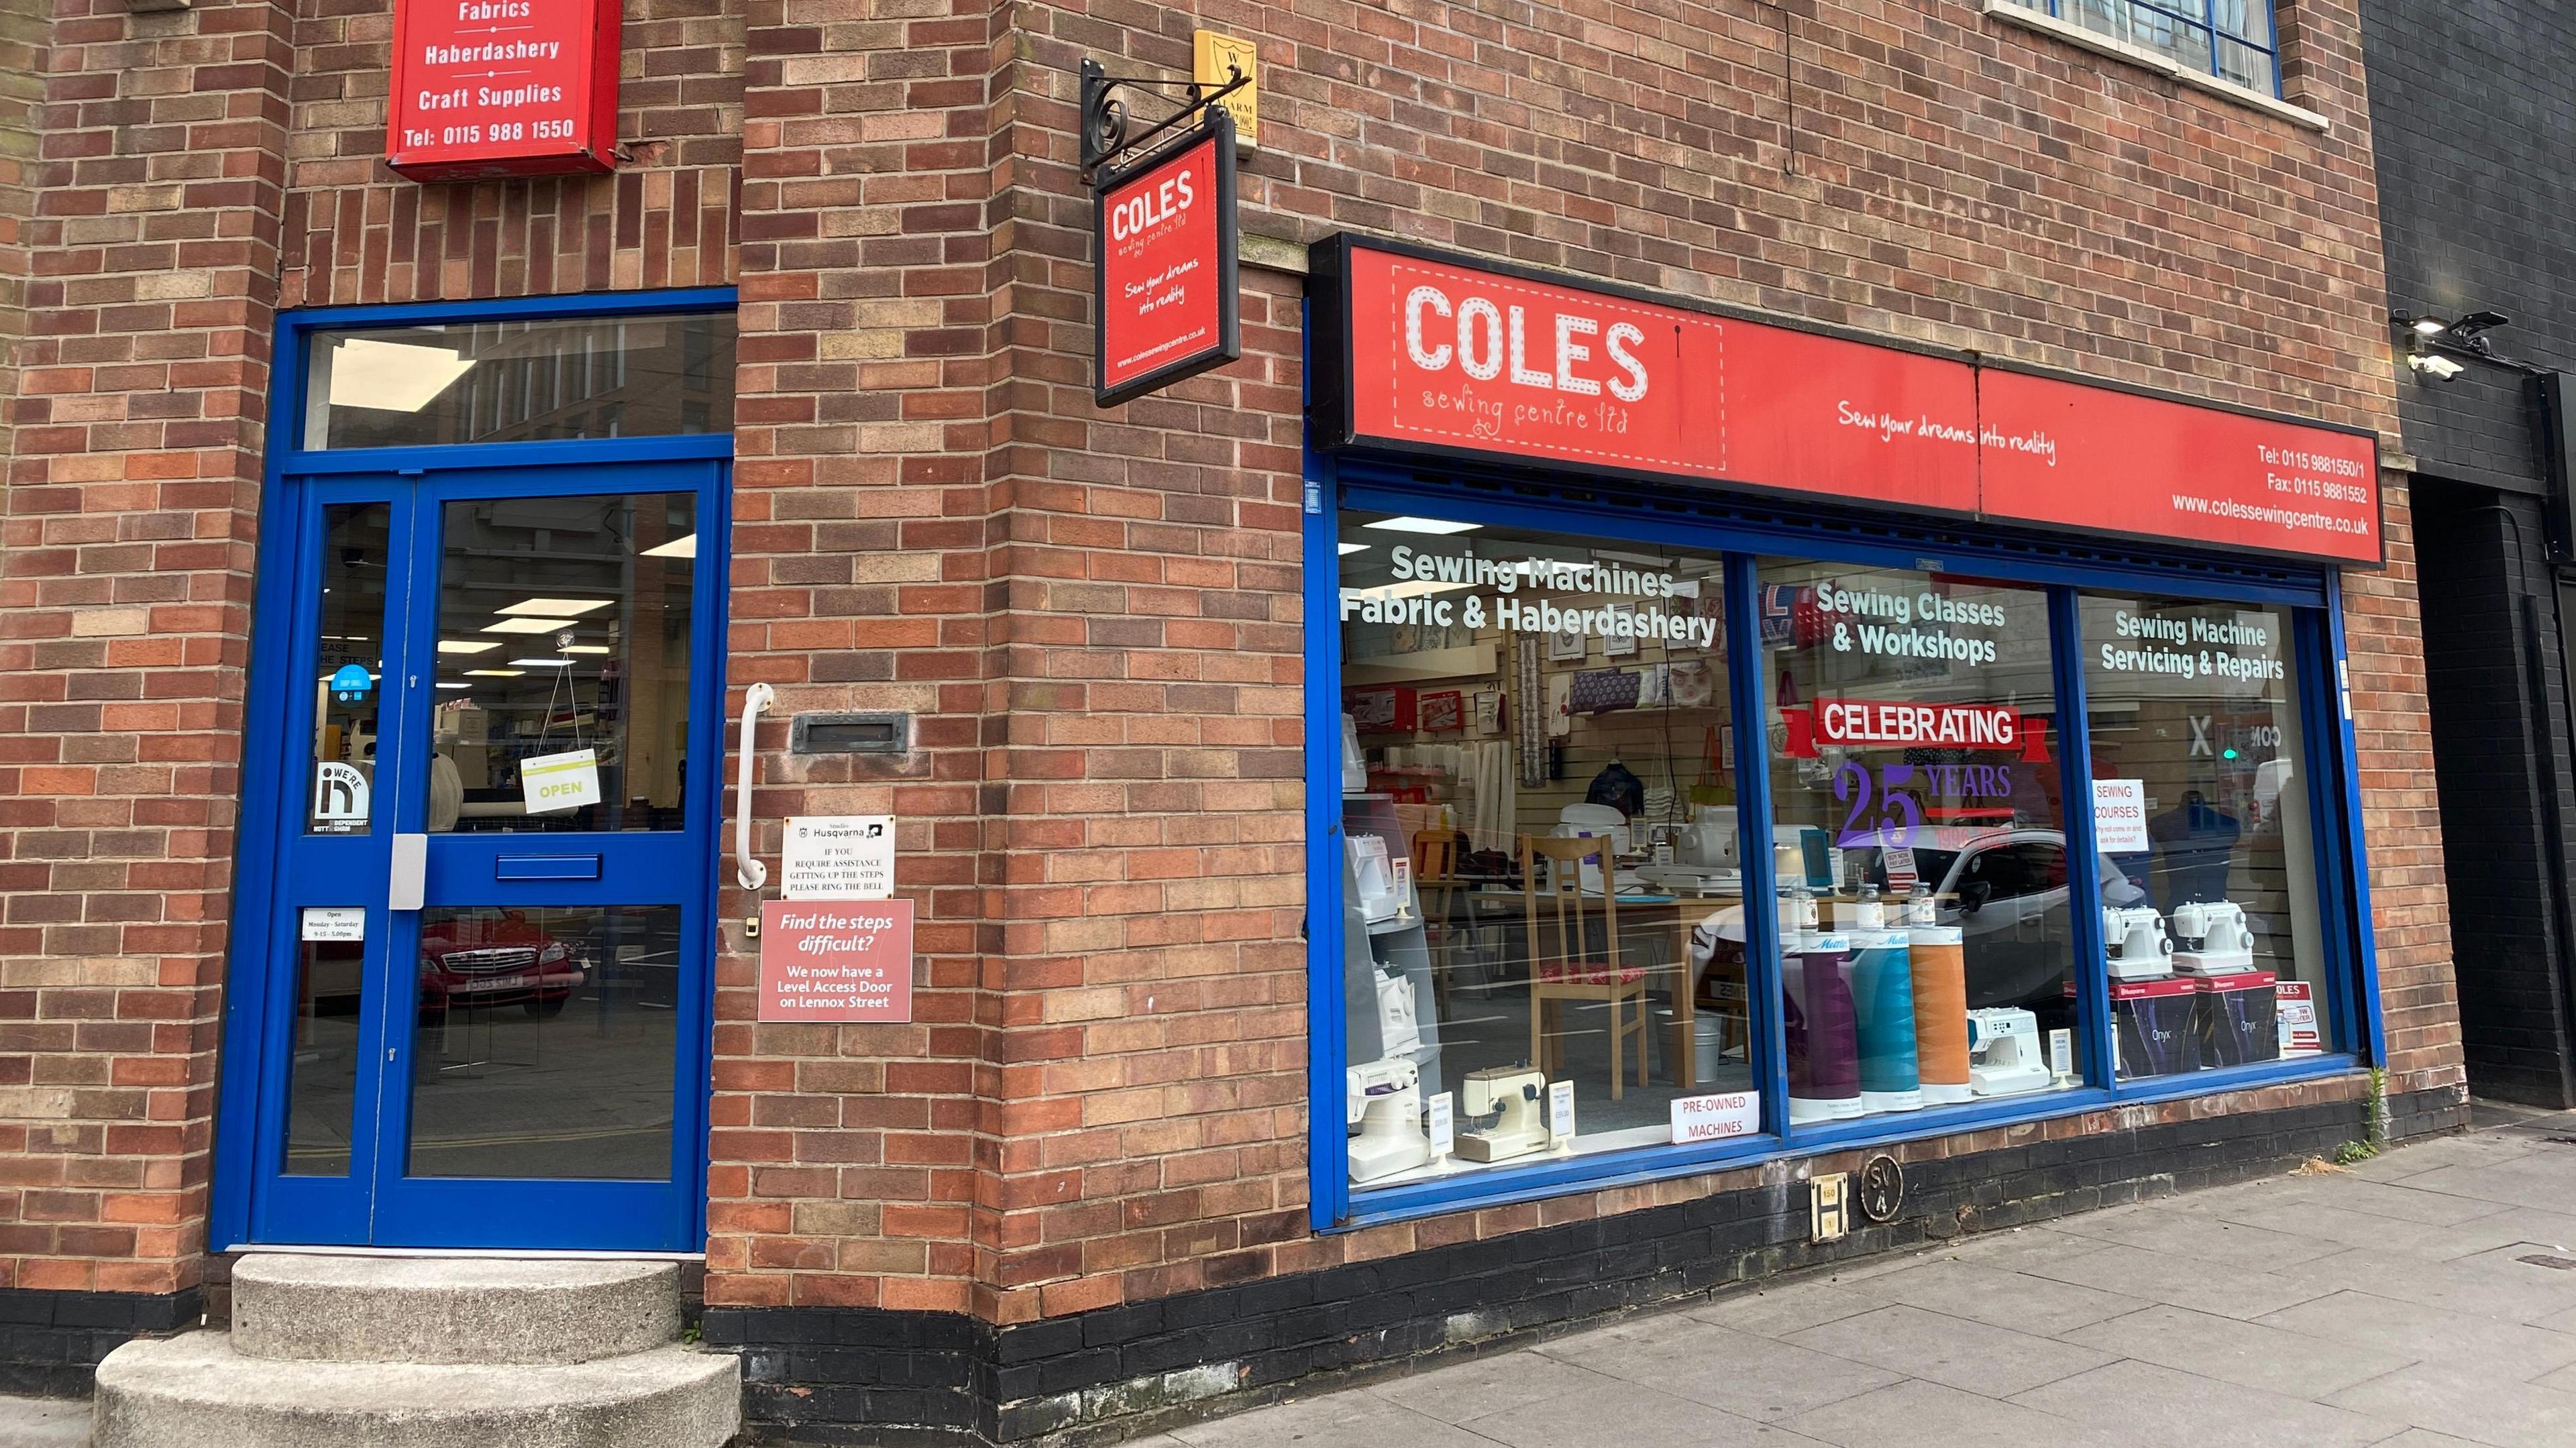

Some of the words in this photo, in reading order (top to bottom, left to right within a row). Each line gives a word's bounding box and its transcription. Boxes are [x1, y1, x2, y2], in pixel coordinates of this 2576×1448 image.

[459, 0, 530, 21] Fabrics
[425, 40, 560, 64] Haberdashery
[419, 89, 468, 110] Craft
[478, 85, 561, 108] Supplies
[405, 129, 435, 147] Tel:
[443, 125, 480, 146] 0115
[489, 123, 523, 142] 988
[532, 119, 574, 139] 1550
[1112, 170, 1194, 241] COLES
[1118, 237, 1145, 258] sewing
[1146, 223, 1173, 246] centre
[1174, 213, 1187, 229] ltd
[1125, 282, 1145, 298] Sew
[1146, 273, 1164, 295] your
[1166, 258, 1199, 280] dreams
[1139, 296, 1155, 316] into
[1156, 284, 1185, 308] reality
[1117, 326, 1206, 368] www.colessewingcentre.co.uk
[1405, 285, 1649, 402] COLES
[1422, 384, 1505, 437] sewing
[1514, 398, 1589, 430] centre
[1595, 402, 1629, 435] ltd
[1837, 400, 1876, 429] Sew
[1880, 412, 1914, 443] your
[1918, 414, 1976, 444] dreams
[1979, 424, 2006, 449] into
[2009, 430, 2057, 467] reality
[2257, 444, 2279, 463] Tel:
[2282, 449, 2308, 469] 0115
[2310, 455, 2365, 480] 9881550/1
[2267, 472, 2292, 492] Fax:
[2294, 477, 2321, 497] 0115
[2322, 481, 2367, 504] 9881552
[2172, 493, 2369, 536] www.colessewingcentre.co.uk
[1391, 545, 1518, 593] Sewing
[1528, 556, 1674, 598] Machines
[1817, 581, 1911, 624] Sewing
[1917, 592, 2006, 627] Classes
[1339, 587, 1453, 628] Fabric
[1462, 595, 1487, 629] &
[1497, 596, 1717, 648] Haberdashery
[2115, 610, 2186, 646] Sewing
[2192, 616, 2267, 647] Machine
[321, 644, 350, 653] EASE
[1833, 622, 1851, 652] &
[1857, 624, 1996, 667] Workshops
[320, 655, 334, 664] HE
[339, 656, 374, 665] STEPS
[2102, 643, 2194, 679] Servicing
[2199, 653, 2212, 675] &
[2216, 652, 2284, 682] Repairs
[1823, 703, 2013, 745] CELEBRATING
[320, 768, 354, 814] in
[334, 768, 362, 790] WE'RE
[539, 781, 582, 798] OPEN
[2096, 785, 2133, 797] SEWING
[1833, 761, 1920, 850] 25
[1925, 764, 2012, 797] YEARS
[2094, 806, 2139, 819] COURSES
[814, 828, 864, 838] Husqvarna
[796, 860, 831, 869] REQUIRE
[833, 859, 881, 867] ASSISTANCE
[335, 921, 359, 929] Saturday
[780, 913, 818, 930] Find
[819, 913, 847, 930] the
[849, 915, 894, 934] steps
[798, 935, 874, 956] difficult?
[786, 965, 808, 978] We
[811, 968, 839, 978] now
[841, 965, 872, 978] have
[875, 968, 883, 978] a
[777, 981, 810, 993] Level
[813, 981, 857, 993] Access
[859, 981, 894, 993] Door
[2276, 985, 2300, 995] OLES
[780, 998, 796, 1008] on
[799, 996, 846, 1008] Lennox
[849, 996, 890, 1008] Street
[2151, 1029, 2171, 1043] Onyx
[2241, 1020, 2257, 1034] Onyx
[1682, 1096, 1746, 1113] PRE-OWNED
[1688, 1121, 1743, 1138] MACHINES
[1823, 1188, 1835, 1198] 150
